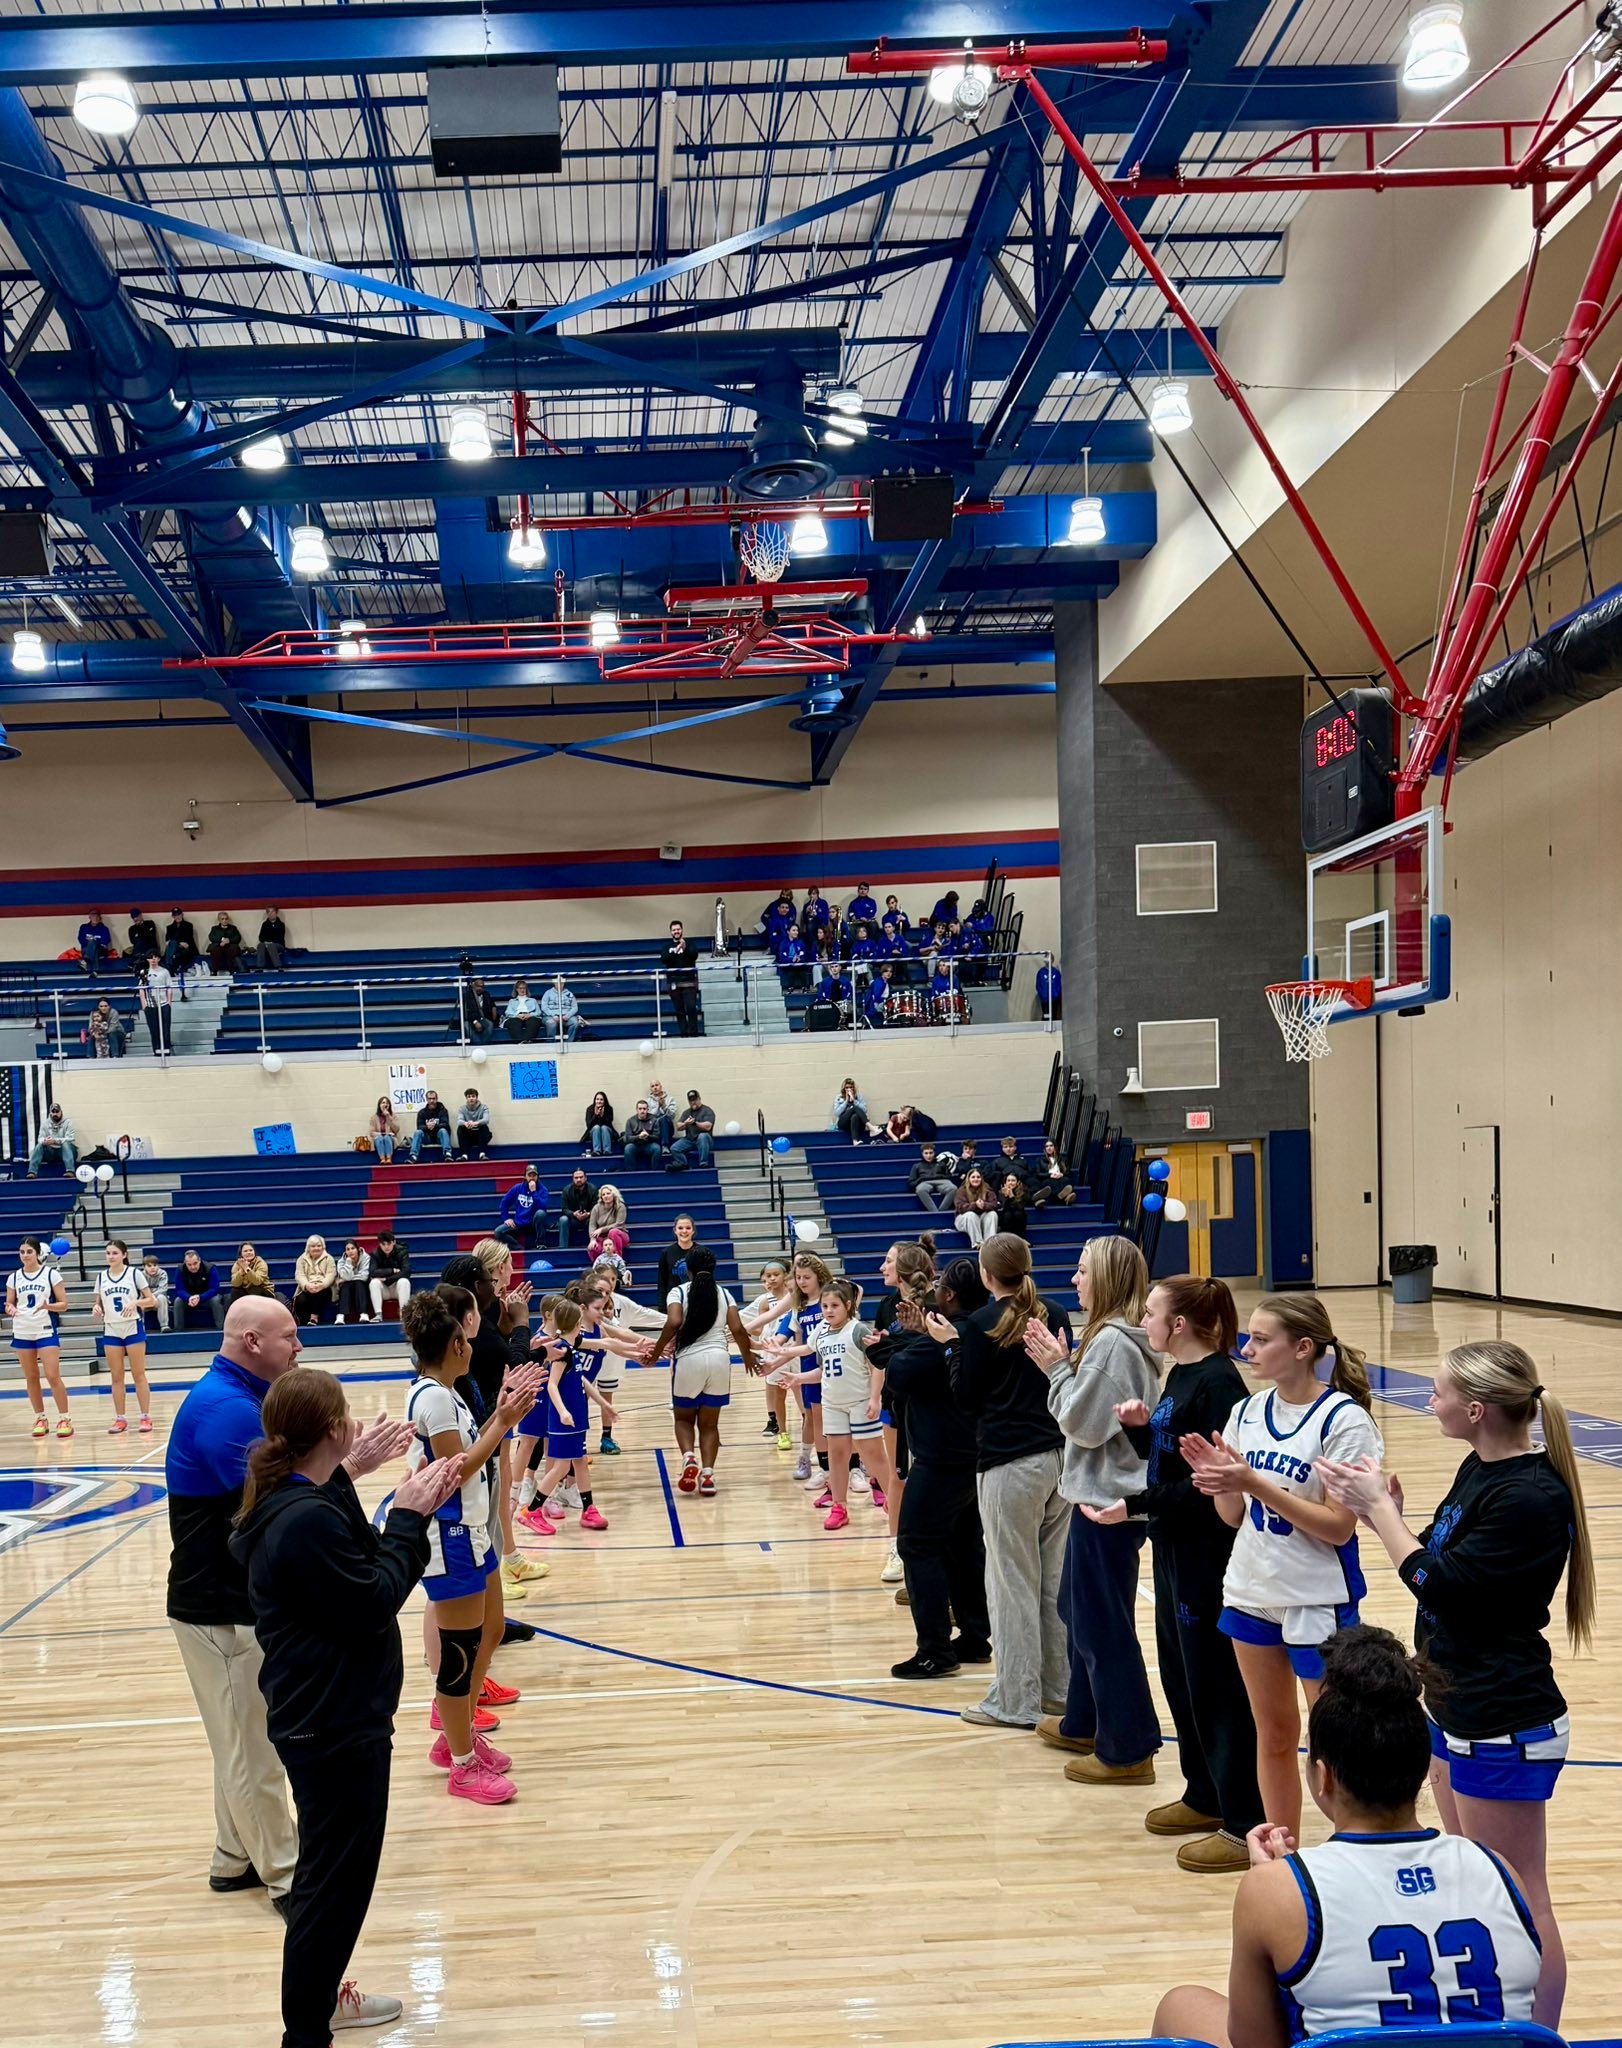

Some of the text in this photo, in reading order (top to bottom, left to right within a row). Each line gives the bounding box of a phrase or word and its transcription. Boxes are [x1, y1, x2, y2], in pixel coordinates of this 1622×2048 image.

[393, 1088, 426, 1104] SENIOR
[113, 1296, 123, 1313] 5
[825, 1358, 843, 1378] 25
[1241, 1450, 1312, 1483] OCKETS
[1397, 1866, 1436, 1893] SG
[1368, 1918, 1505, 2026] 33
